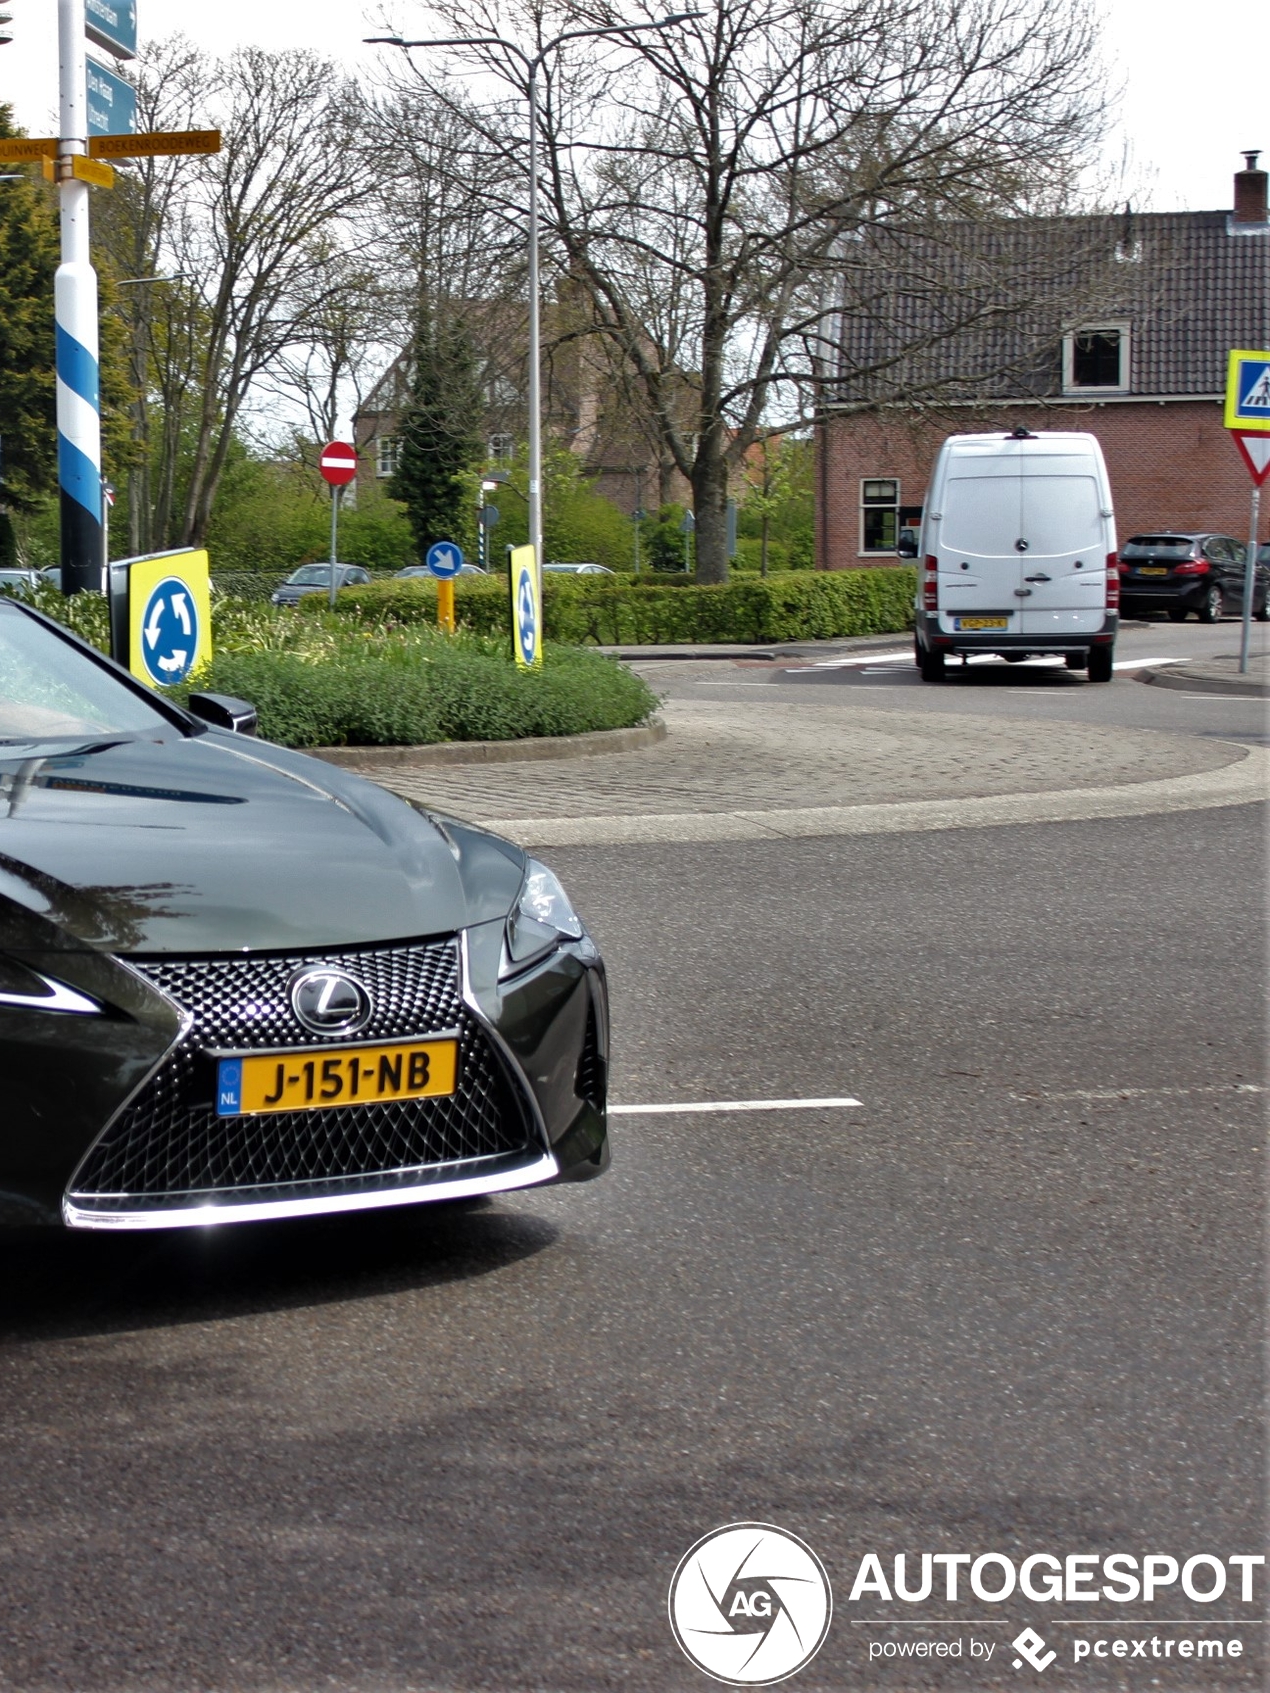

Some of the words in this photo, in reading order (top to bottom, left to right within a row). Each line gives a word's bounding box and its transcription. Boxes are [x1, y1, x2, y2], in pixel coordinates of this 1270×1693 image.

[87, 68, 98, 93] Den
[99, 77, 113, 108] Haag
[98, 135, 211, 154] BOEKENROODEWEG
[220, 1091, 238, 1106] NL
[264, 1051, 431, 1104] J-151-NB
